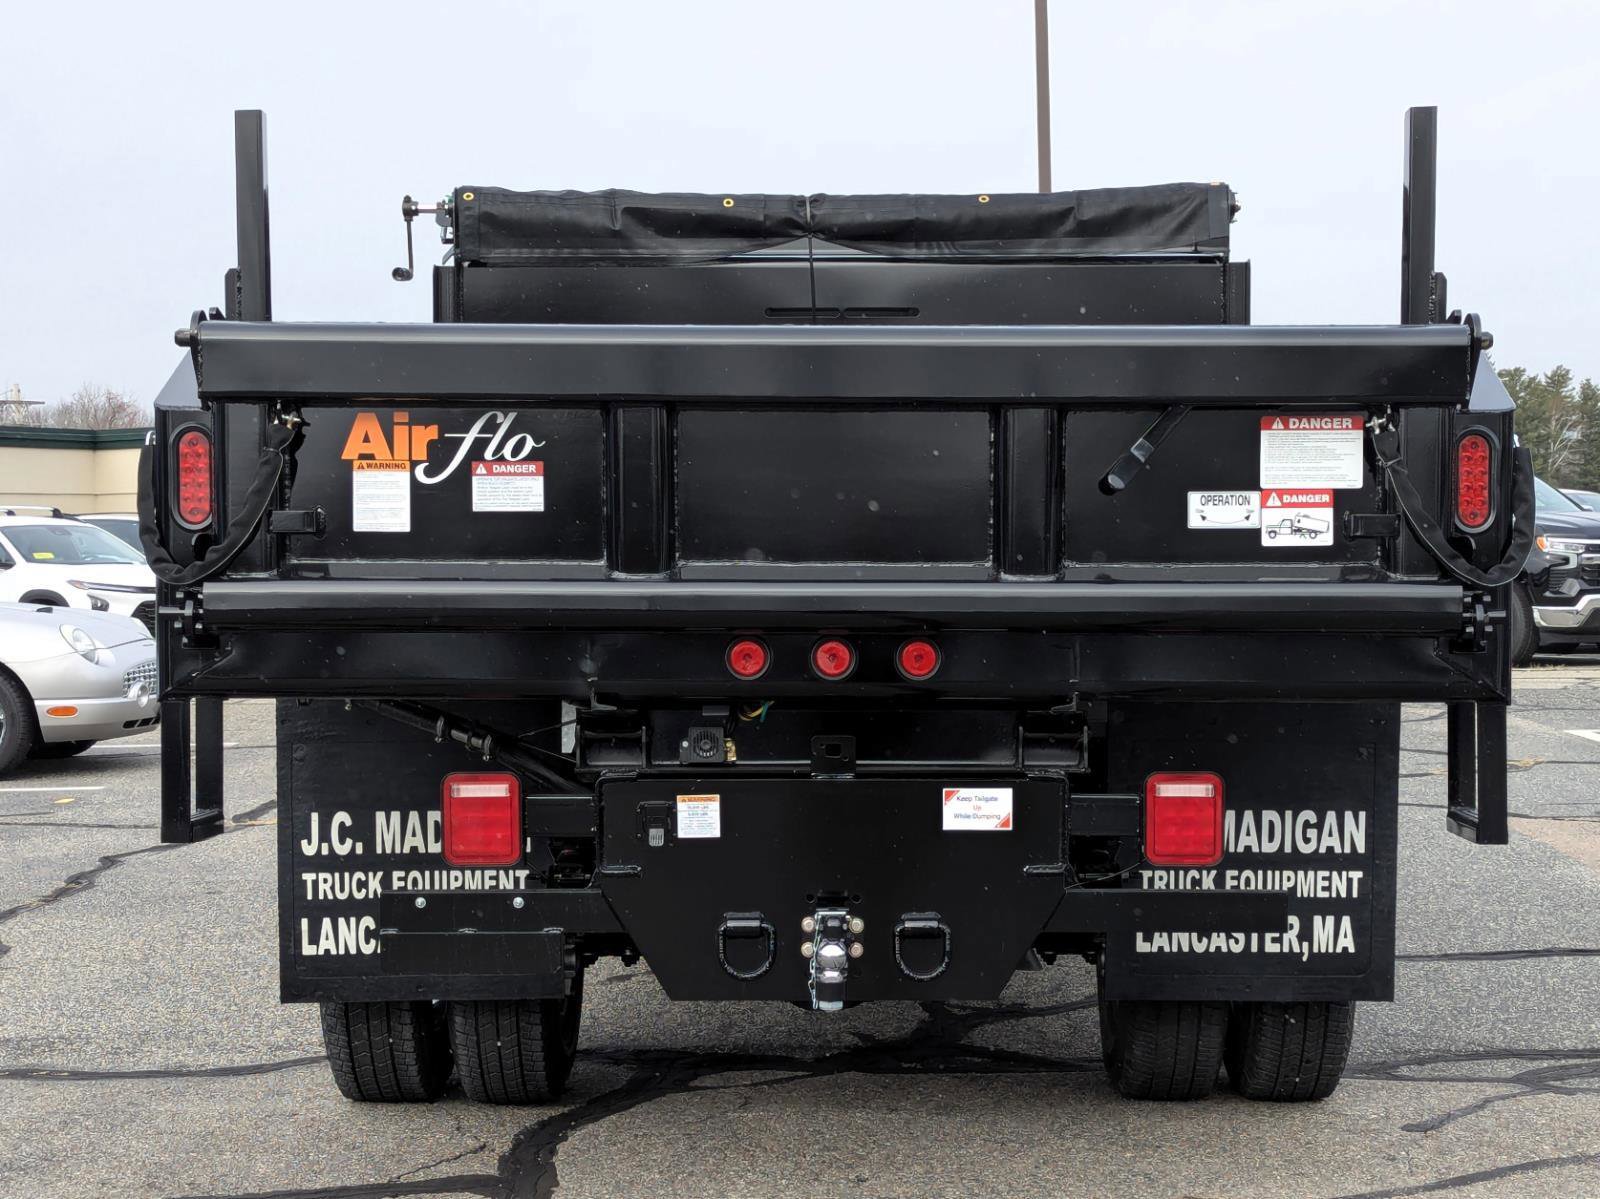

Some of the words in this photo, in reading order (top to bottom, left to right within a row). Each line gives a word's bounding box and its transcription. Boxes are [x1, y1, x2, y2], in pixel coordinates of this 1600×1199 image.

[1288, 417, 1353, 429] DANGER
[340, 411, 439, 460] Air
[414, 410, 546, 485] flo
[365, 462, 407, 470] WARNING
[492, 464, 537, 473] DANGER
[1200, 494, 1251, 506] OPERATION
[1282, 494, 1330, 503] DANGER
[974, 795, 999, 803] Tailgate
[972, 813, 1001, 821] Dumping
[300, 811, 363, 856] J.C.
[301, 870, 384, 900] TRUCK
[301, 915, 381, 956] LANC
